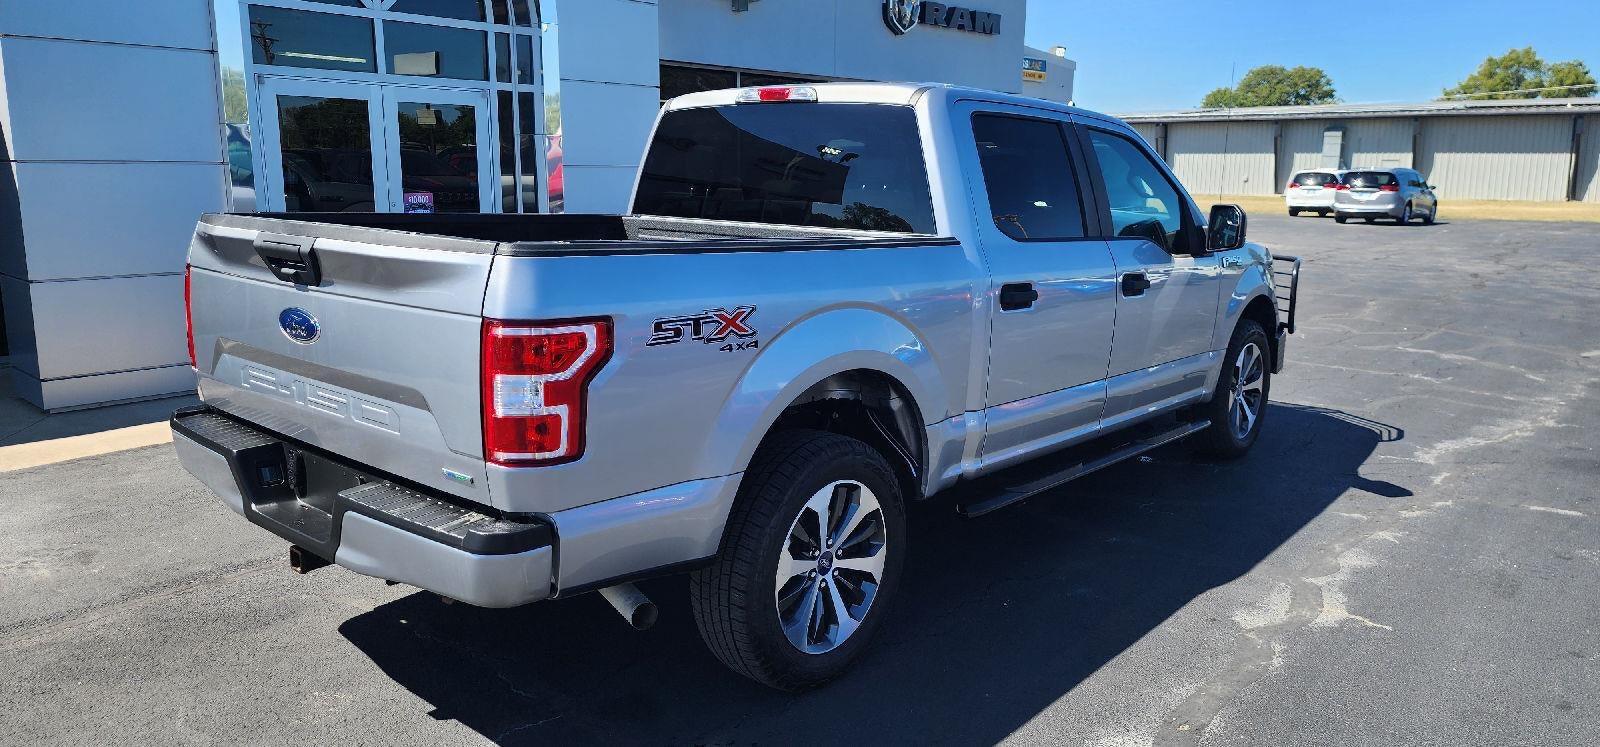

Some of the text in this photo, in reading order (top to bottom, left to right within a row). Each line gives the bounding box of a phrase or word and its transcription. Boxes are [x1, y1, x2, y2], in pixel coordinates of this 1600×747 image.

[920, 1, 1001, 34] RAM
[645, 304, 759, 346] STX
[241, 364, 401, 435] F-150
